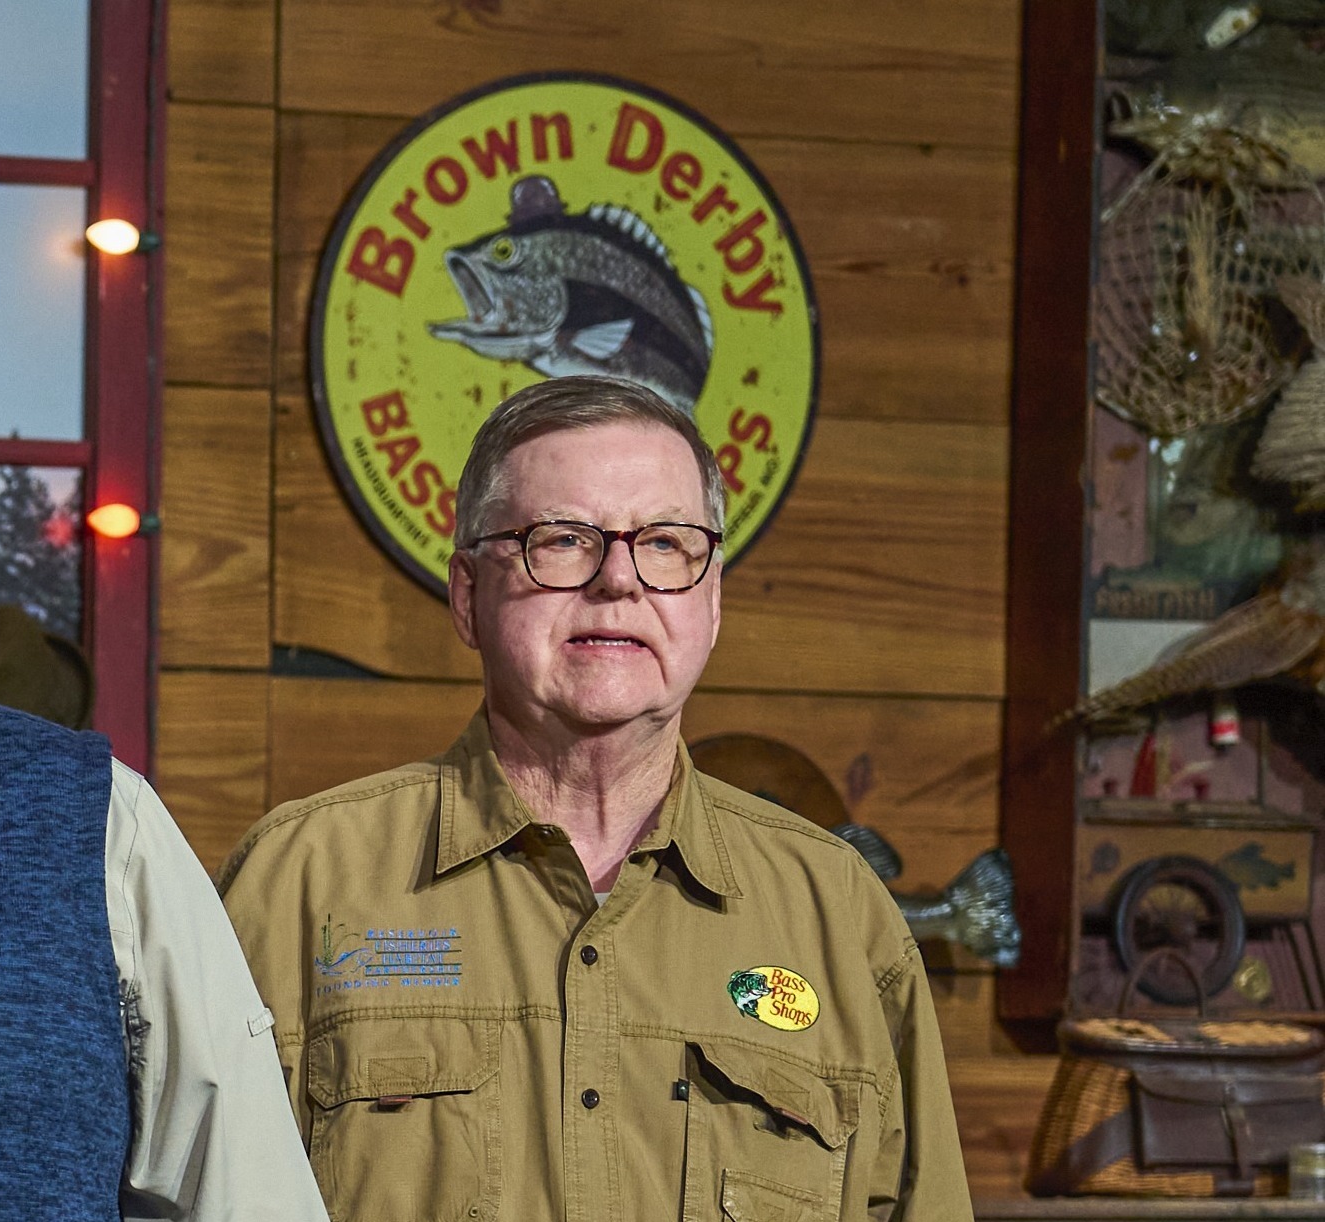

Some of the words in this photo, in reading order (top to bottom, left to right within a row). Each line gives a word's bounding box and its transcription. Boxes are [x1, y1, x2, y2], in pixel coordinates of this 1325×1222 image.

[347, 112, 574, 297] Brown
[607, 102, 783, 318] Derby
[360, 390, 456, 538] BASS
[770, 969, 806, 993] Bass
[771, 986, 796, 1004] Pro
[769, 1000, 813, 1026] Shops
